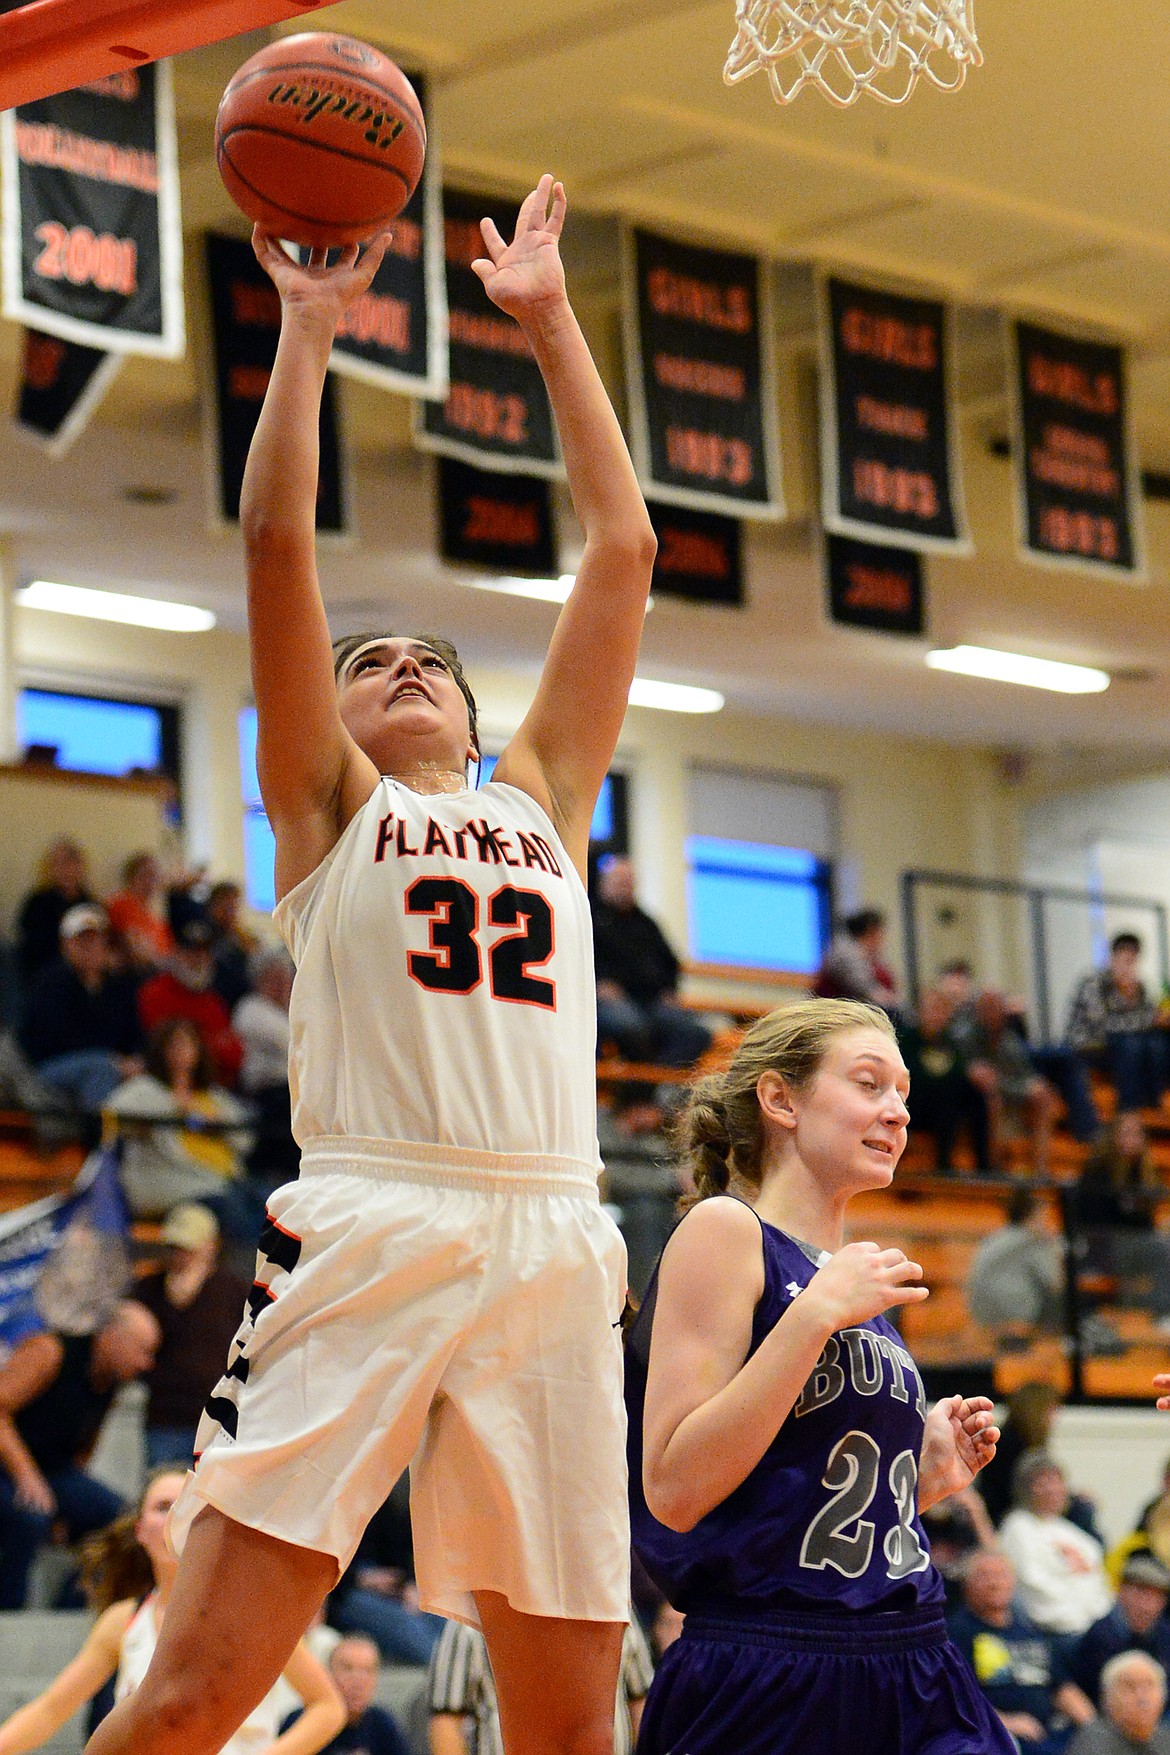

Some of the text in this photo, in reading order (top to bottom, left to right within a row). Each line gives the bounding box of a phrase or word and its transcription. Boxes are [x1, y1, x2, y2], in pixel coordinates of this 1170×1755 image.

[268, 83, 404, 149] Baden
[374, 812, 563, 879] FLATHEAD
[404, 875, 557, 1013] 32
